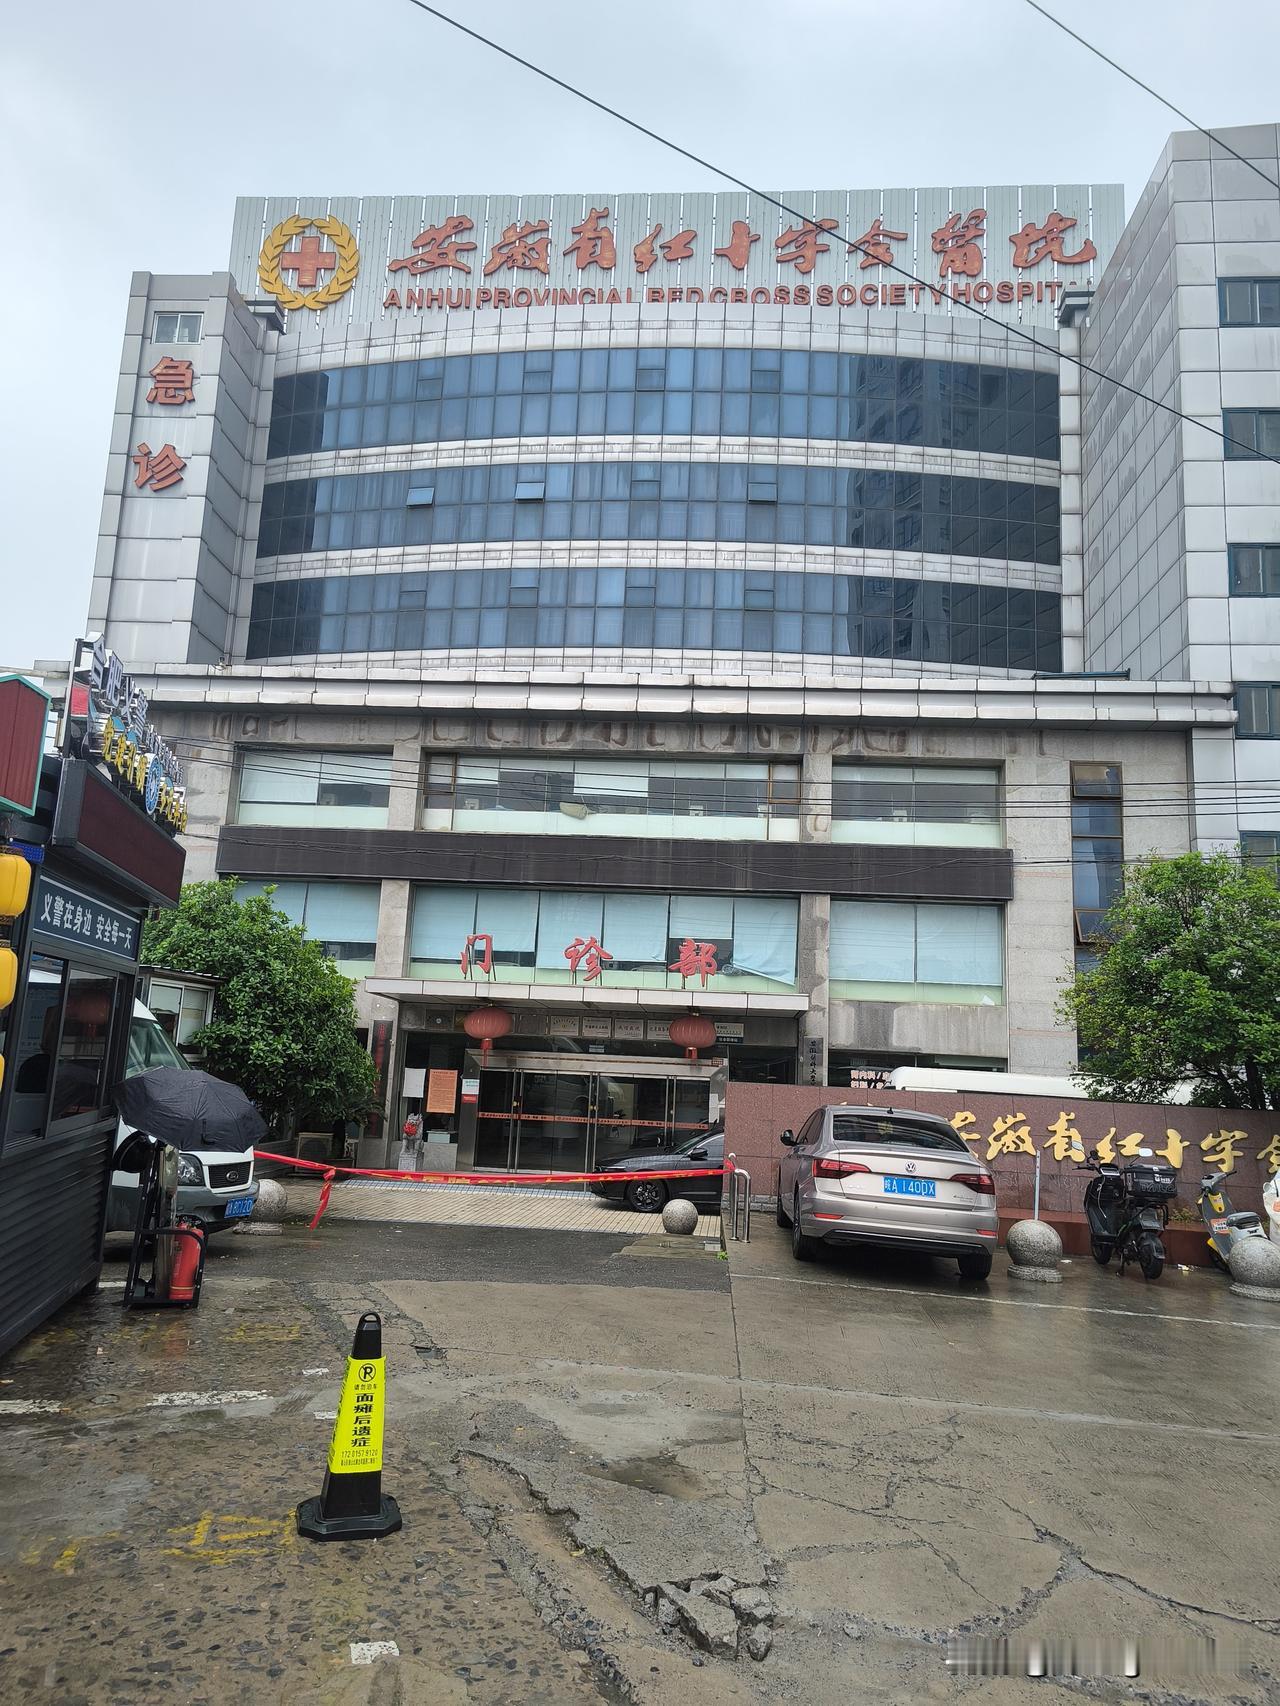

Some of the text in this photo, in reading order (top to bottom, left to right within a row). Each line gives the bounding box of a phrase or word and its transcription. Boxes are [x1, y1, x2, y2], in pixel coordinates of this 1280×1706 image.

[383, 287, 471, 309] ANHUI
[709, 285, 811, 305] CROSS
[816, 283, 946, 306] SOCIETY
[133, 356, 197, 492] 急诊
[41, 893, 132, 949] 义警在身边 安全每一天
[459, 934, 718, 988] 门诊部
[351, 1393, 374, 1447] 面瘫后遗症
